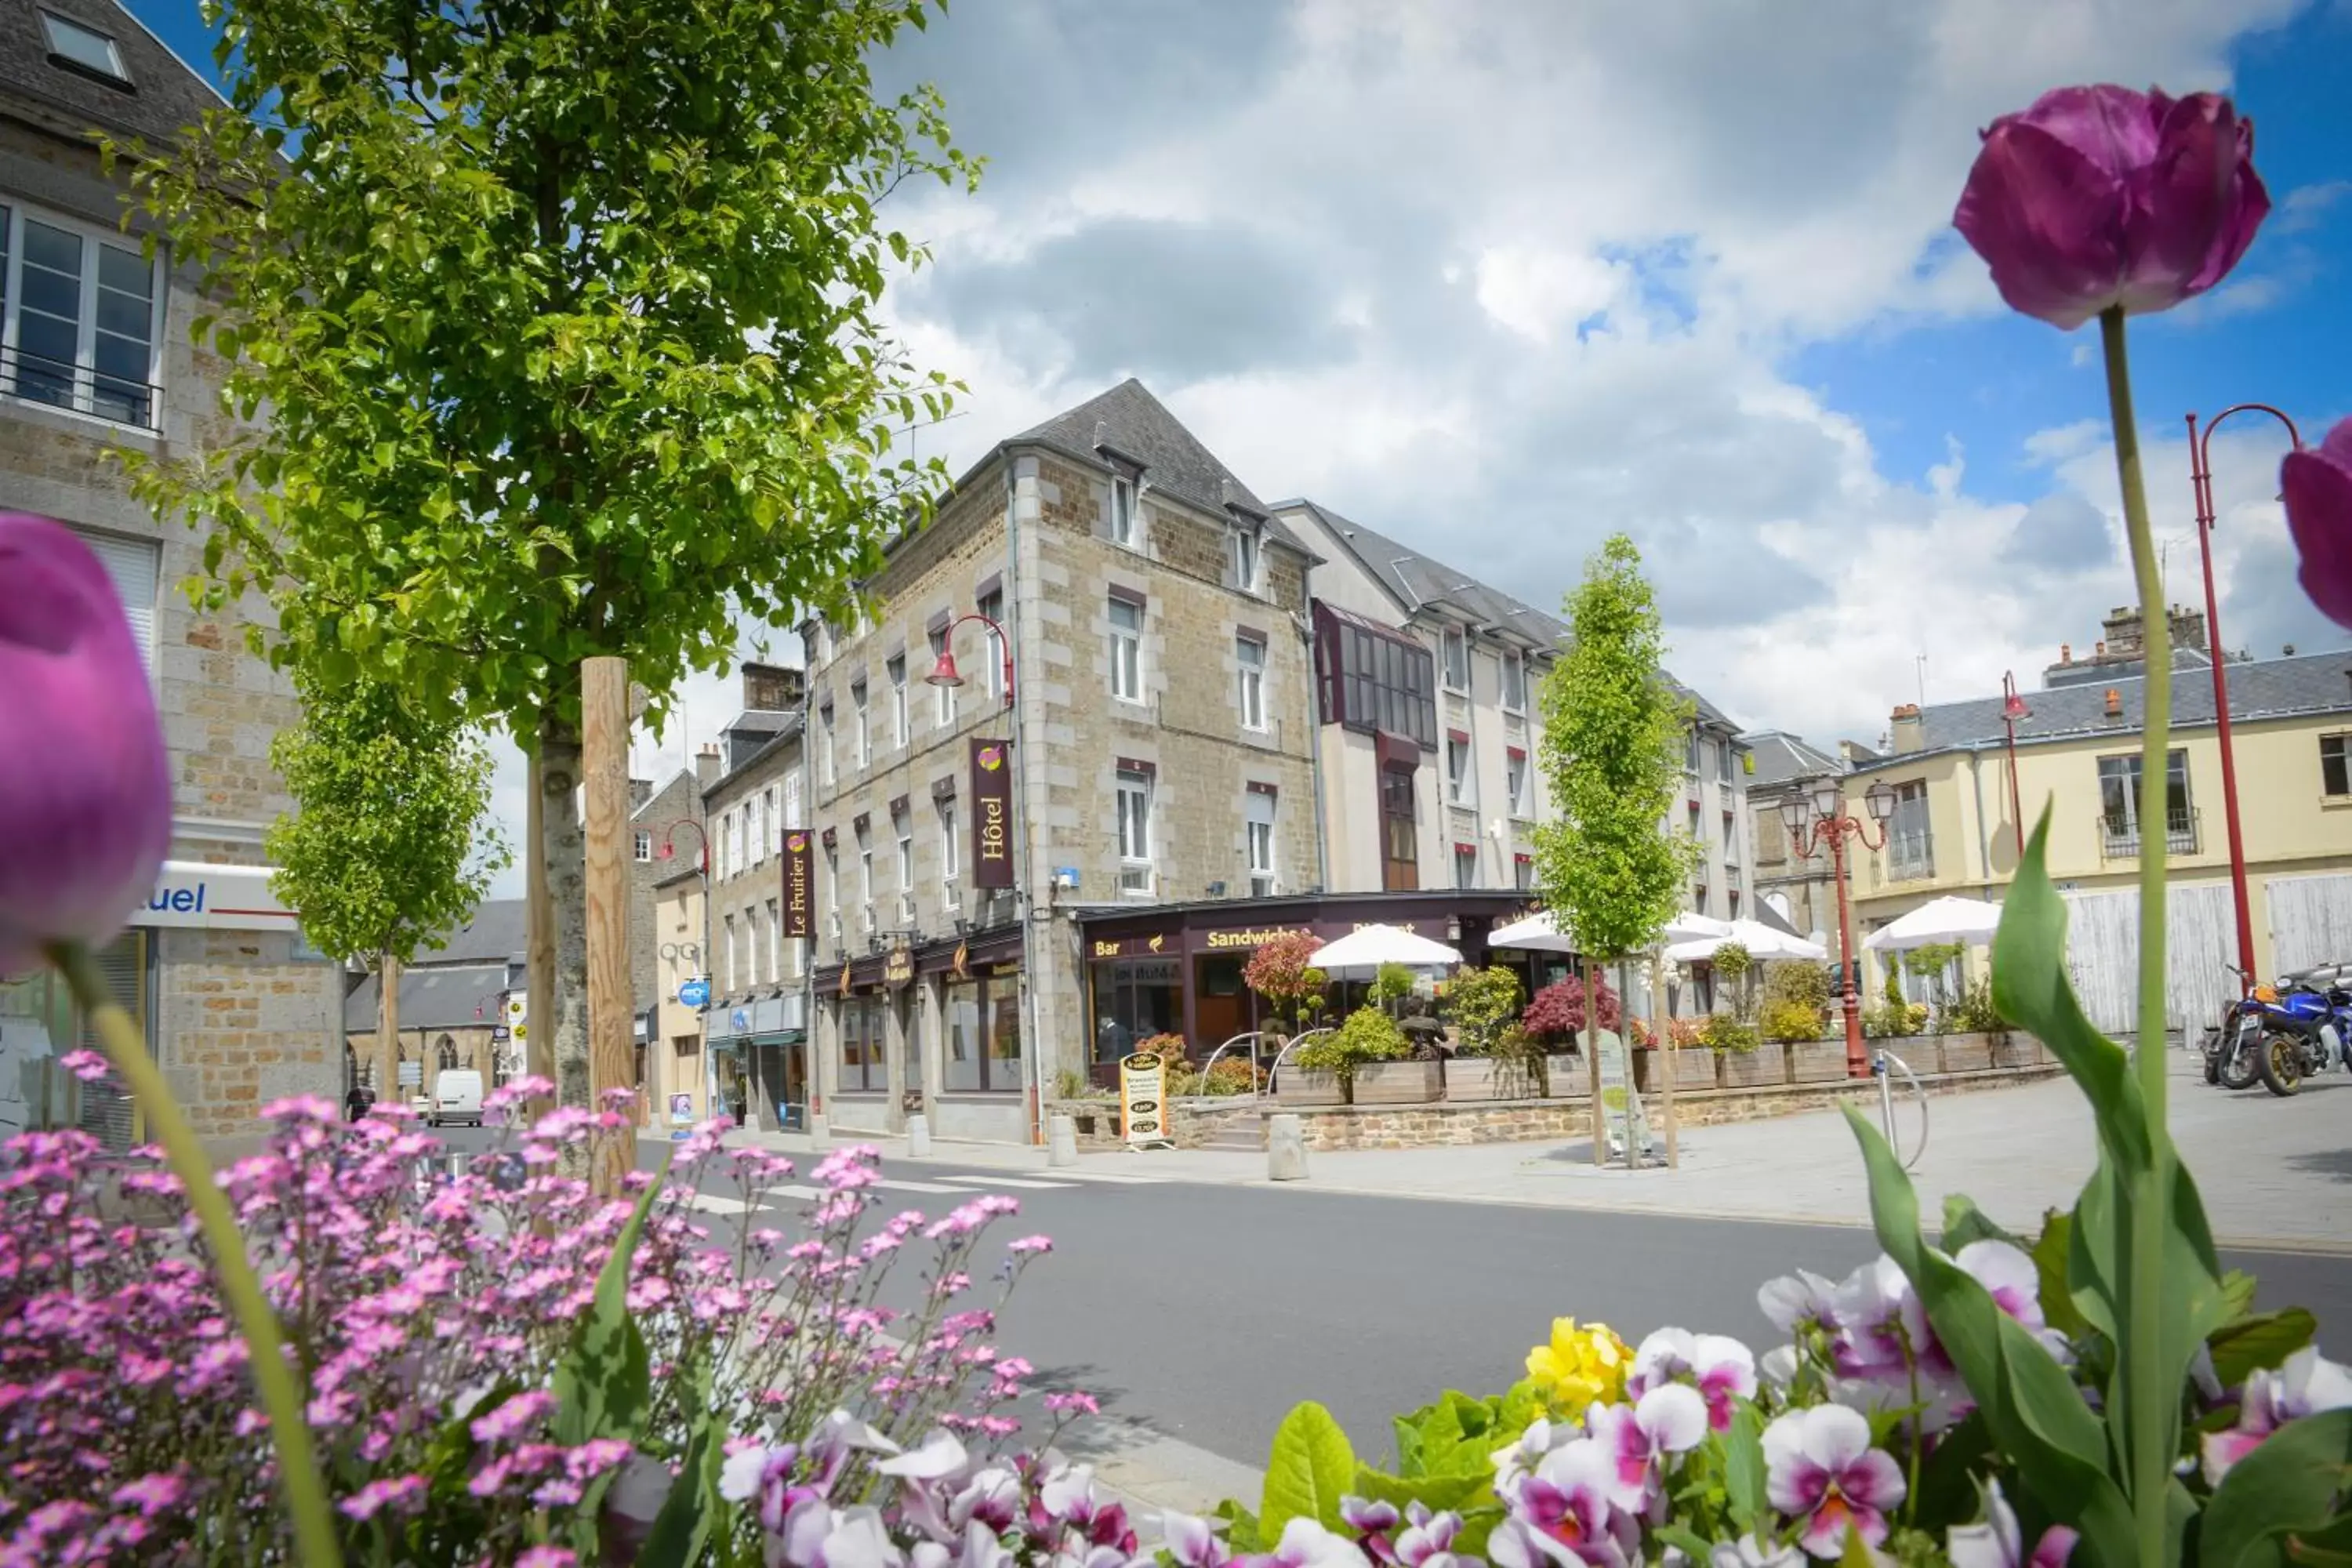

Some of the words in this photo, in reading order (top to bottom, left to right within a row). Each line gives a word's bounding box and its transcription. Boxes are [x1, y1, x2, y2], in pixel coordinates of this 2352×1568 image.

[980, 797, 1004, 861] Hôtel
[146, 882, 205, 913] uel
[789, 857, 805, 912] Fruitier
[790, 916, 805, 935] Le
[1095, 941, 1120, 956] Bar
